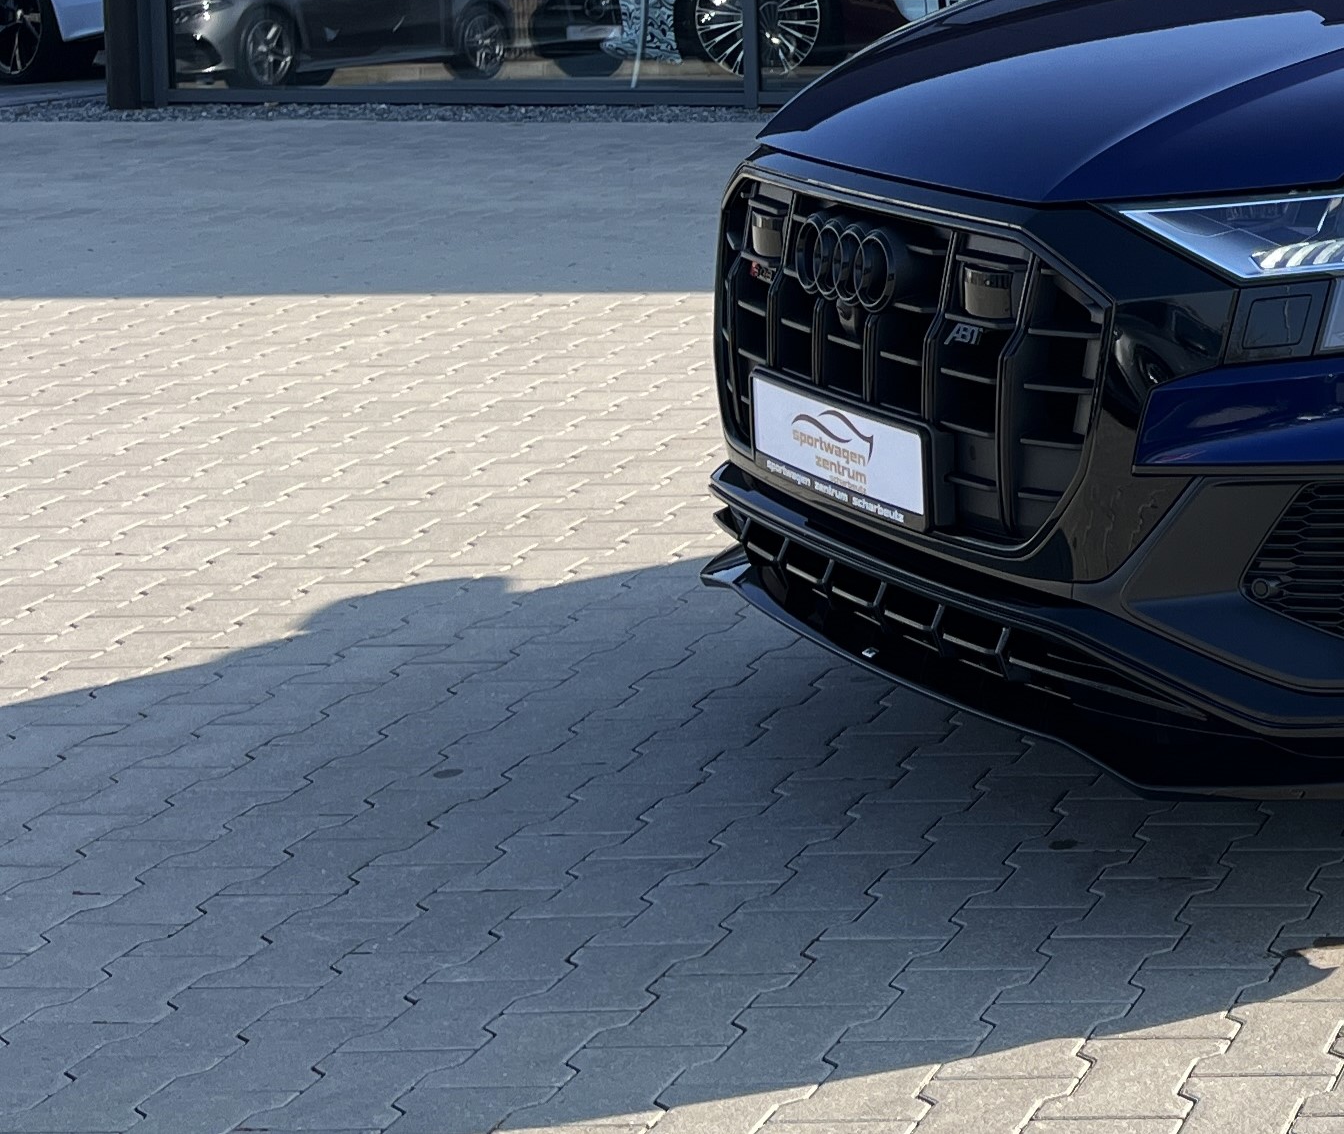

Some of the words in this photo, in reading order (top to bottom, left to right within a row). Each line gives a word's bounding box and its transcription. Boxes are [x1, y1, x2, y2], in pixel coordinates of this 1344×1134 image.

[943, 322, 984, 345] ABT
[792, 429, 866, 467] sportwagen
[815, 455, 867, 485] zentrum
[814, 480, 849, 503] zentrum
[852, 496, 905, 523] scharbeutz
